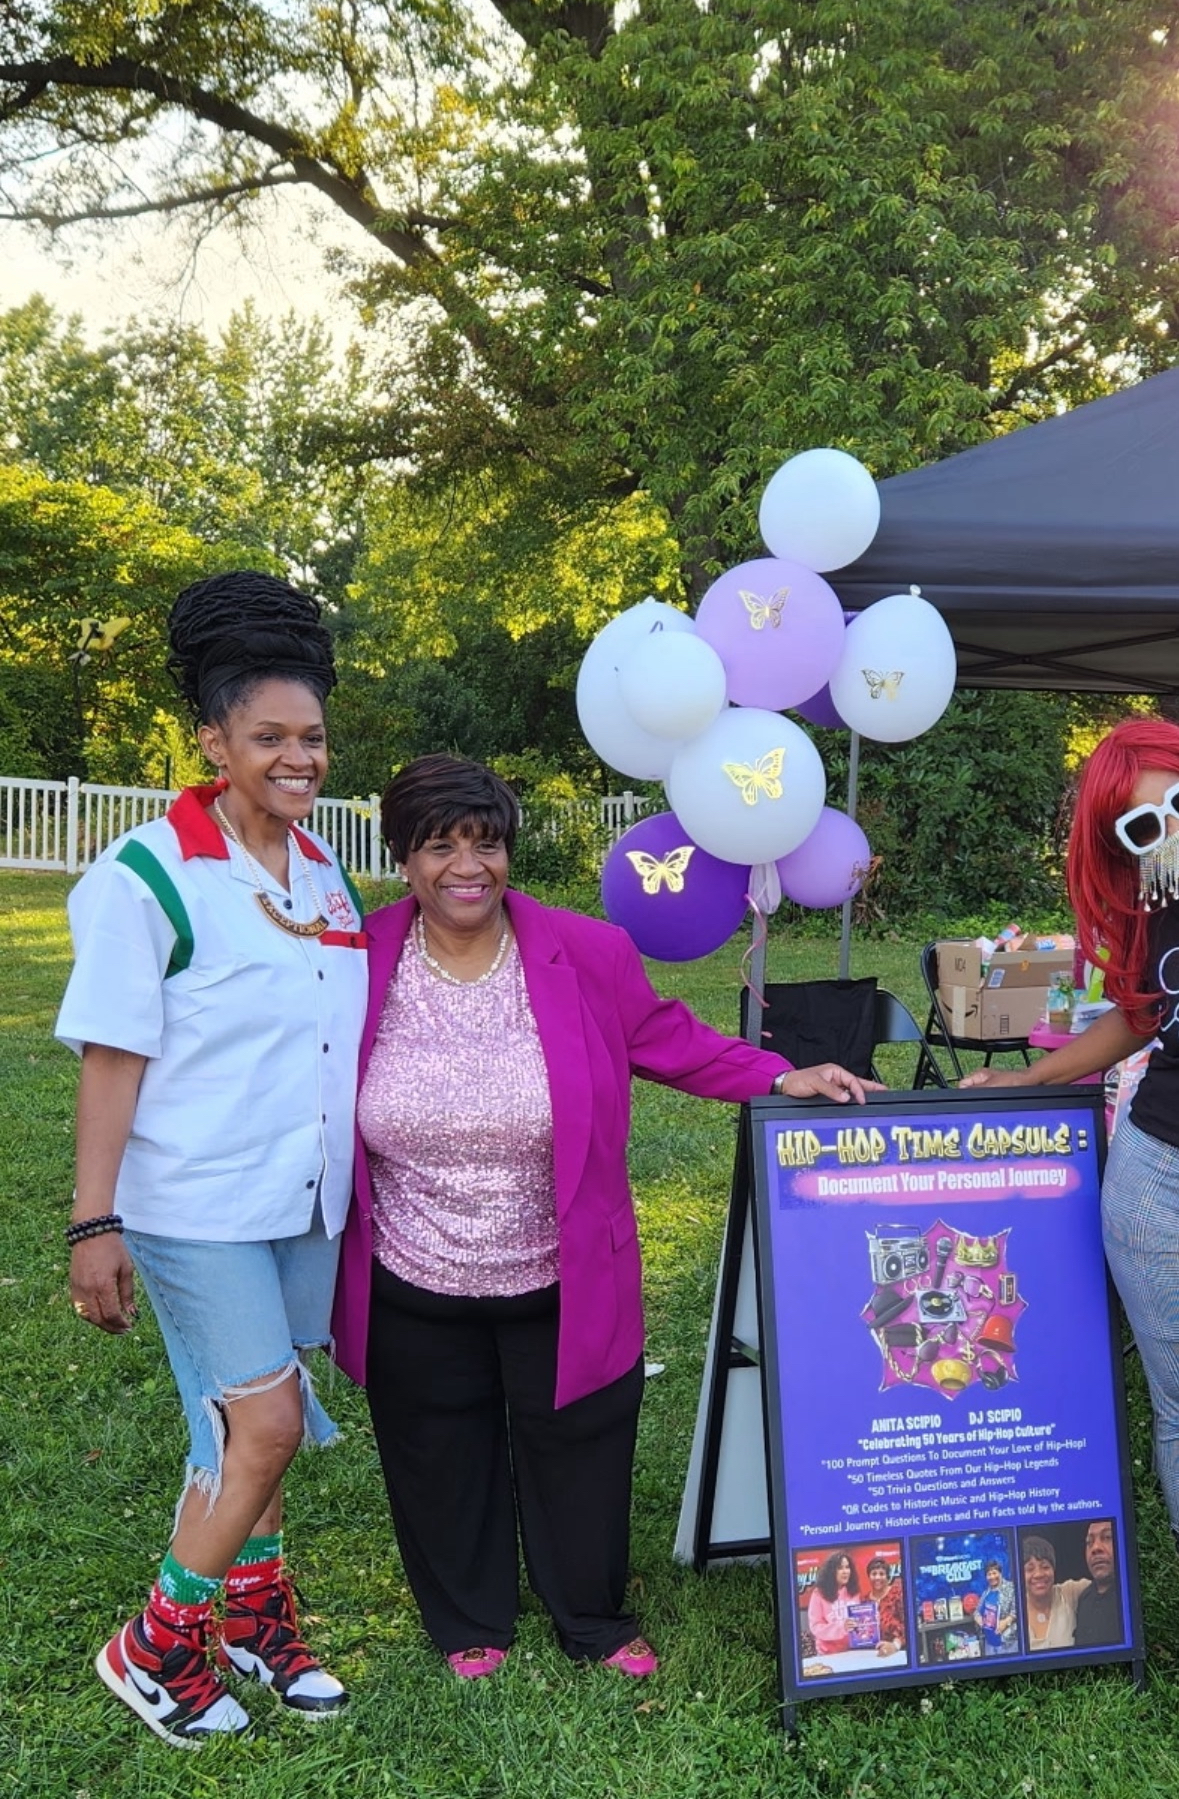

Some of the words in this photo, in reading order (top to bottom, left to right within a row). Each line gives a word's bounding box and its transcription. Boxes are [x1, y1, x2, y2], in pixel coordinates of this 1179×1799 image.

[777, 1127, 887, 1167] HIP-HOP
[891, 1125, 962, 1161] TIME
[967, 1122, 1072, 1159] CAPSULE
[818, 1174, 899, 1196] Document
[899, 1172, 935, 1193] Your
[937, 1168, 1006, 1191] Personal
[1008, 1167, 1067, 1188] Journey
[871, 1417, 905, 1433] ANITA
[906, 1414, 942, 1430] SCIPIO
[968, 1411, 984, 1425] DJ
[986, 1408, 1022, 1424] SCIPIO
[922, 1433, 935, 1446] 50
[936, 1430, 965, 1444] Years
[966, 1429, 978, 1442] of
[978, 1426, 1014, 1442] Hip-Hop
[846, 1456, 880, 1469] Prompt
[882, 1452, 927, 1466] Questions
[928, 1450, 940, 1461] To
[942, 1446, 987, 1460] Document
[988, 1444, 1010, 1456] Your
[1011, 1442, 1033, 1454] Love
[1034, 1440, 1045, 1452] of
[1046, 1437, 1087, 1452] Hip-Hop!
[866, 1470, 904, 1483] Timeless
[906, 1468, 938, 1480] Quotes
[939, 1465, 963, 1477] From
[964, 1463, 982, 1475] Our
[984, 1460, 1022, 1474] Hip-Hop
[1023, 1456, 1060, 1470] Legends
[886, 1483, 912, 1495] Trivia
[914, 1479, 959, 1493] Questions
[960, 1478, 977, 1489] and
[979, 1475, 1016, 1487] Answers
[861, 1502, 889, 1514] Codes
[891, 1501, 902, 1511] to
[903, 1496, 939, 1510] Historic
[941, 1494, 968, 1506] Music
[969, 1492, 986, 1504] and
[988, 1489, 1027, 1503] Hip-Hop
[1028, 1486, 1061, 1499] History
[884, 1516, 920, 1528] Historic
[922, 1513, 953, 1525] Events
[954, 1510, 971, 1521] and
[973, 1508, 990, 1519] Fun
[992, 1505, 1016, 1518] Facts
[1017, 1503, 1035, 1515] told
[1037, 1502, 1049, 1515] by
[1050, 1501, 1065, 1512] the
[1066, 1498, 1103, 1511] authors.
[931, 1559, 982, 1577] BREAKFAST
[945, 1569, 972, 1583] CLUB
